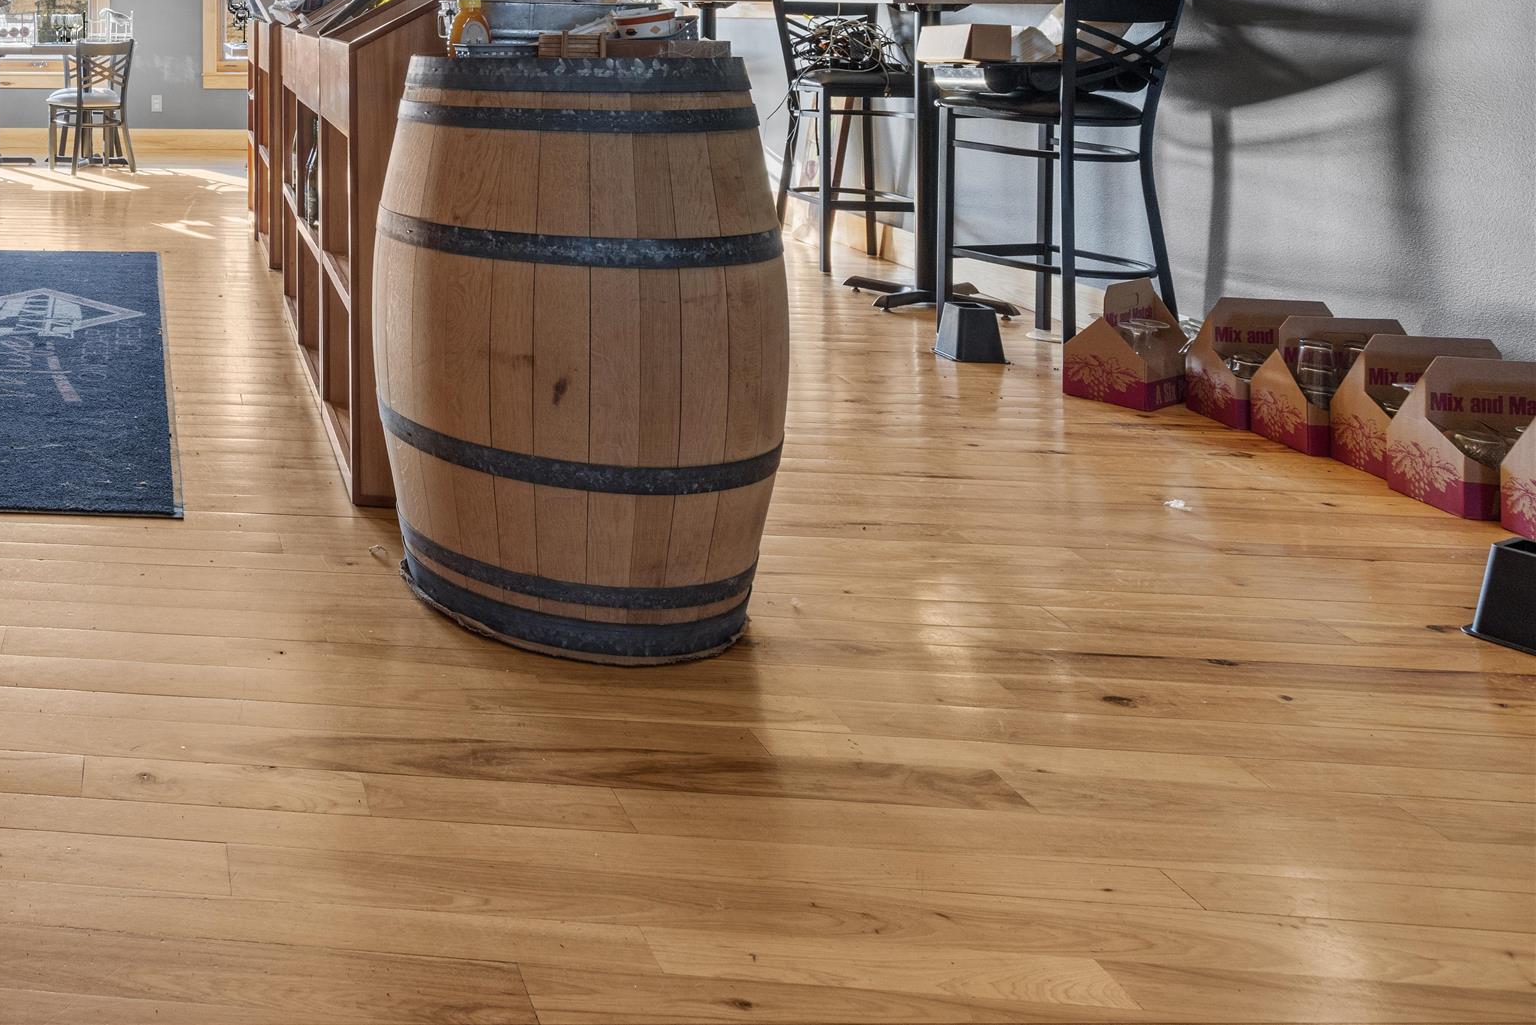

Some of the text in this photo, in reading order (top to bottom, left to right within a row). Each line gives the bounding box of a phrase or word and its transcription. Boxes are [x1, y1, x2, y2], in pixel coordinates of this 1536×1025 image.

[1215, 327, 1274, 345] Mix and
[1368, 367, 1398, 386] Mix
[1430, 391, 1536, 416] Mix and Ma
